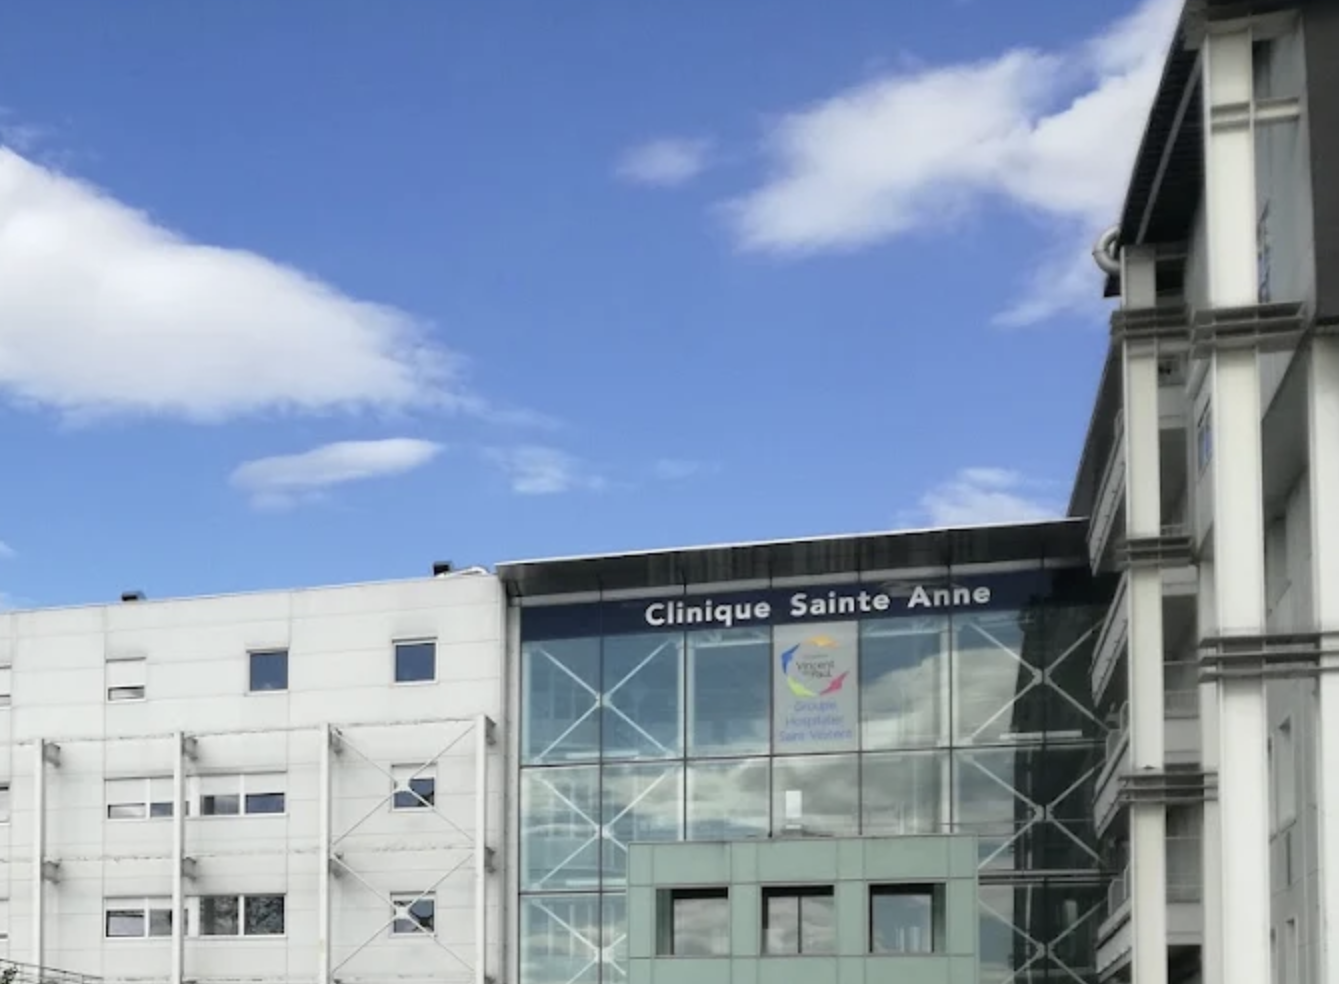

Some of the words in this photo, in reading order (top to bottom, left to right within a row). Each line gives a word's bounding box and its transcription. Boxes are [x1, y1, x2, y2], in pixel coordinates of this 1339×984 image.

[645, 600, 771, 627] Clinique
[790, 591, 891, 617] Sainte
[907, 585, 991, 608] Anne
